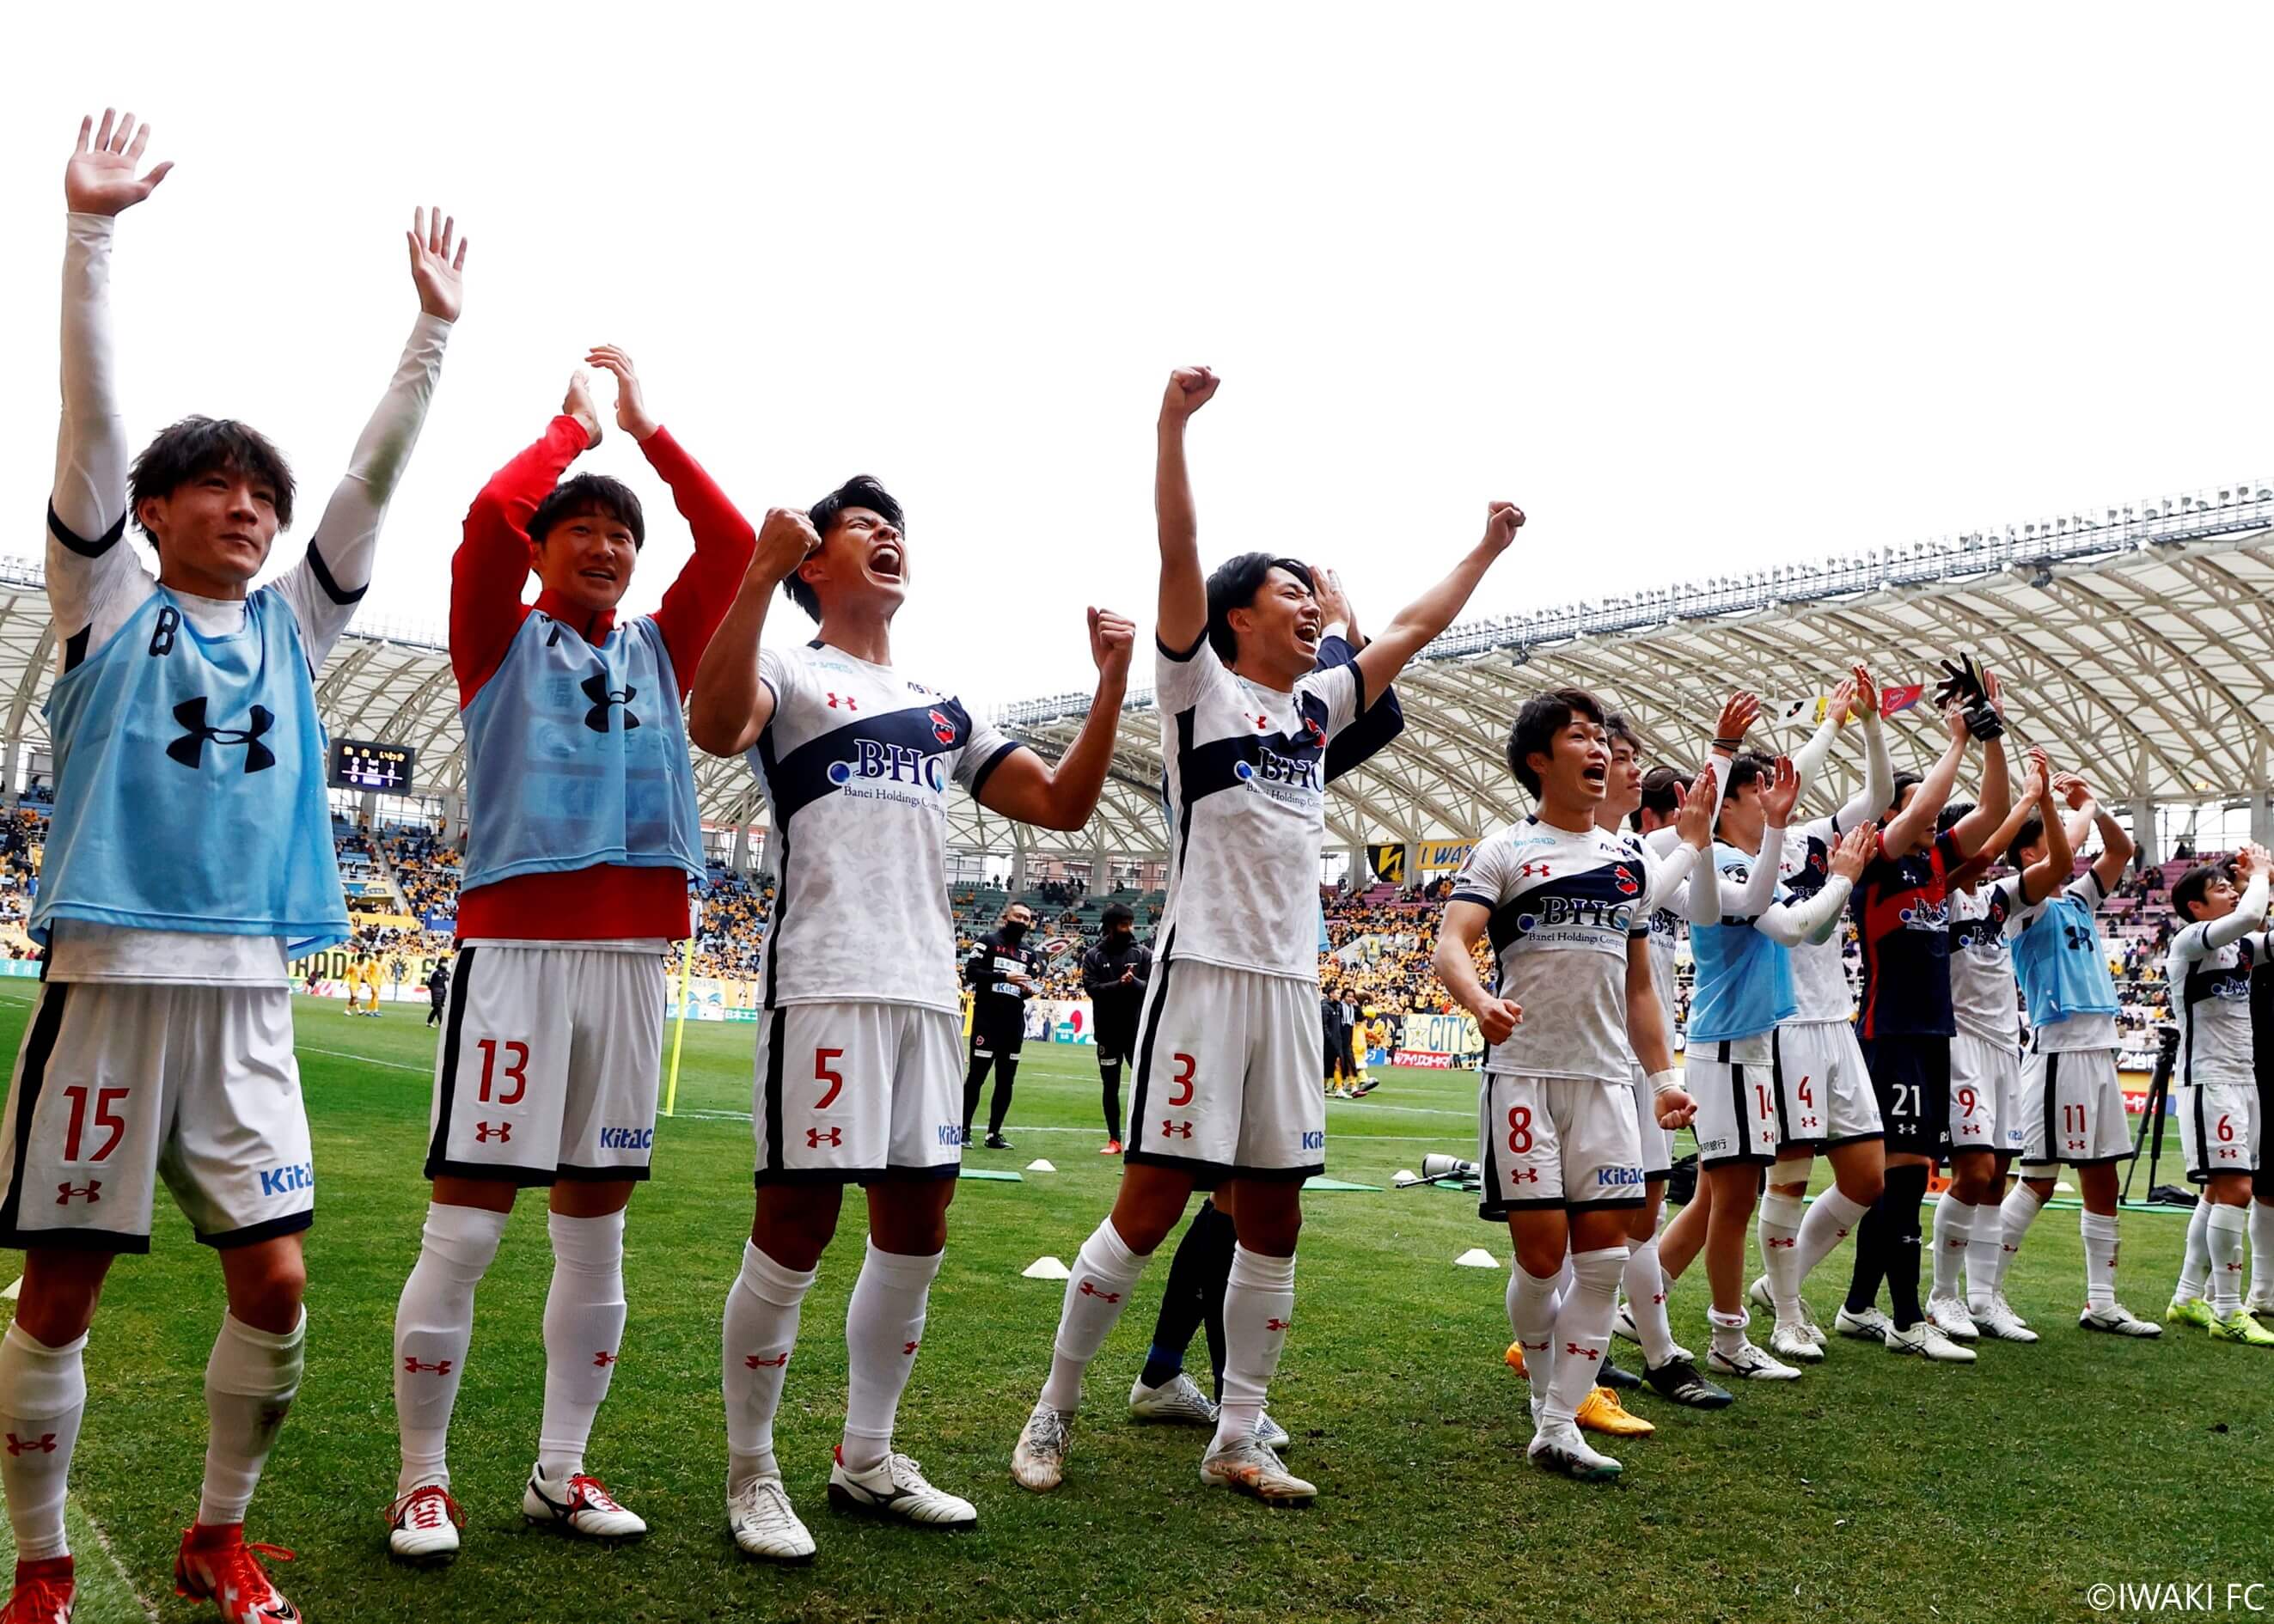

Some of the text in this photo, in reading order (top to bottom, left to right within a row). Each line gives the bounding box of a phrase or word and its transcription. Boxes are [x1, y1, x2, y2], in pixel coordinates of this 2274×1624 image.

[844, 785, 873, 799] Banei
[876, 789, 920, 809] Holdings
[1557, 932, 1598, 945] Holdings
[1429, 1017, 1468, 1052] CITY
[477, 1039, 529, 1105] 13
[813, 1047, 844, 1109] 5
[1168, 1053, 1196, 1107] 3
[1798, 1076, 1812, 1108] 4
[1892, 1084, 1921, 1117] 21
[1958, 1088, 1976, 1118] 9
[63, 1085, 131, 1162] 15
[1507, 1106, 1533, 1154] 8
[2063, 1104, 2086, 1133] 11
[2216, 1114, 2234, 1142] 6
